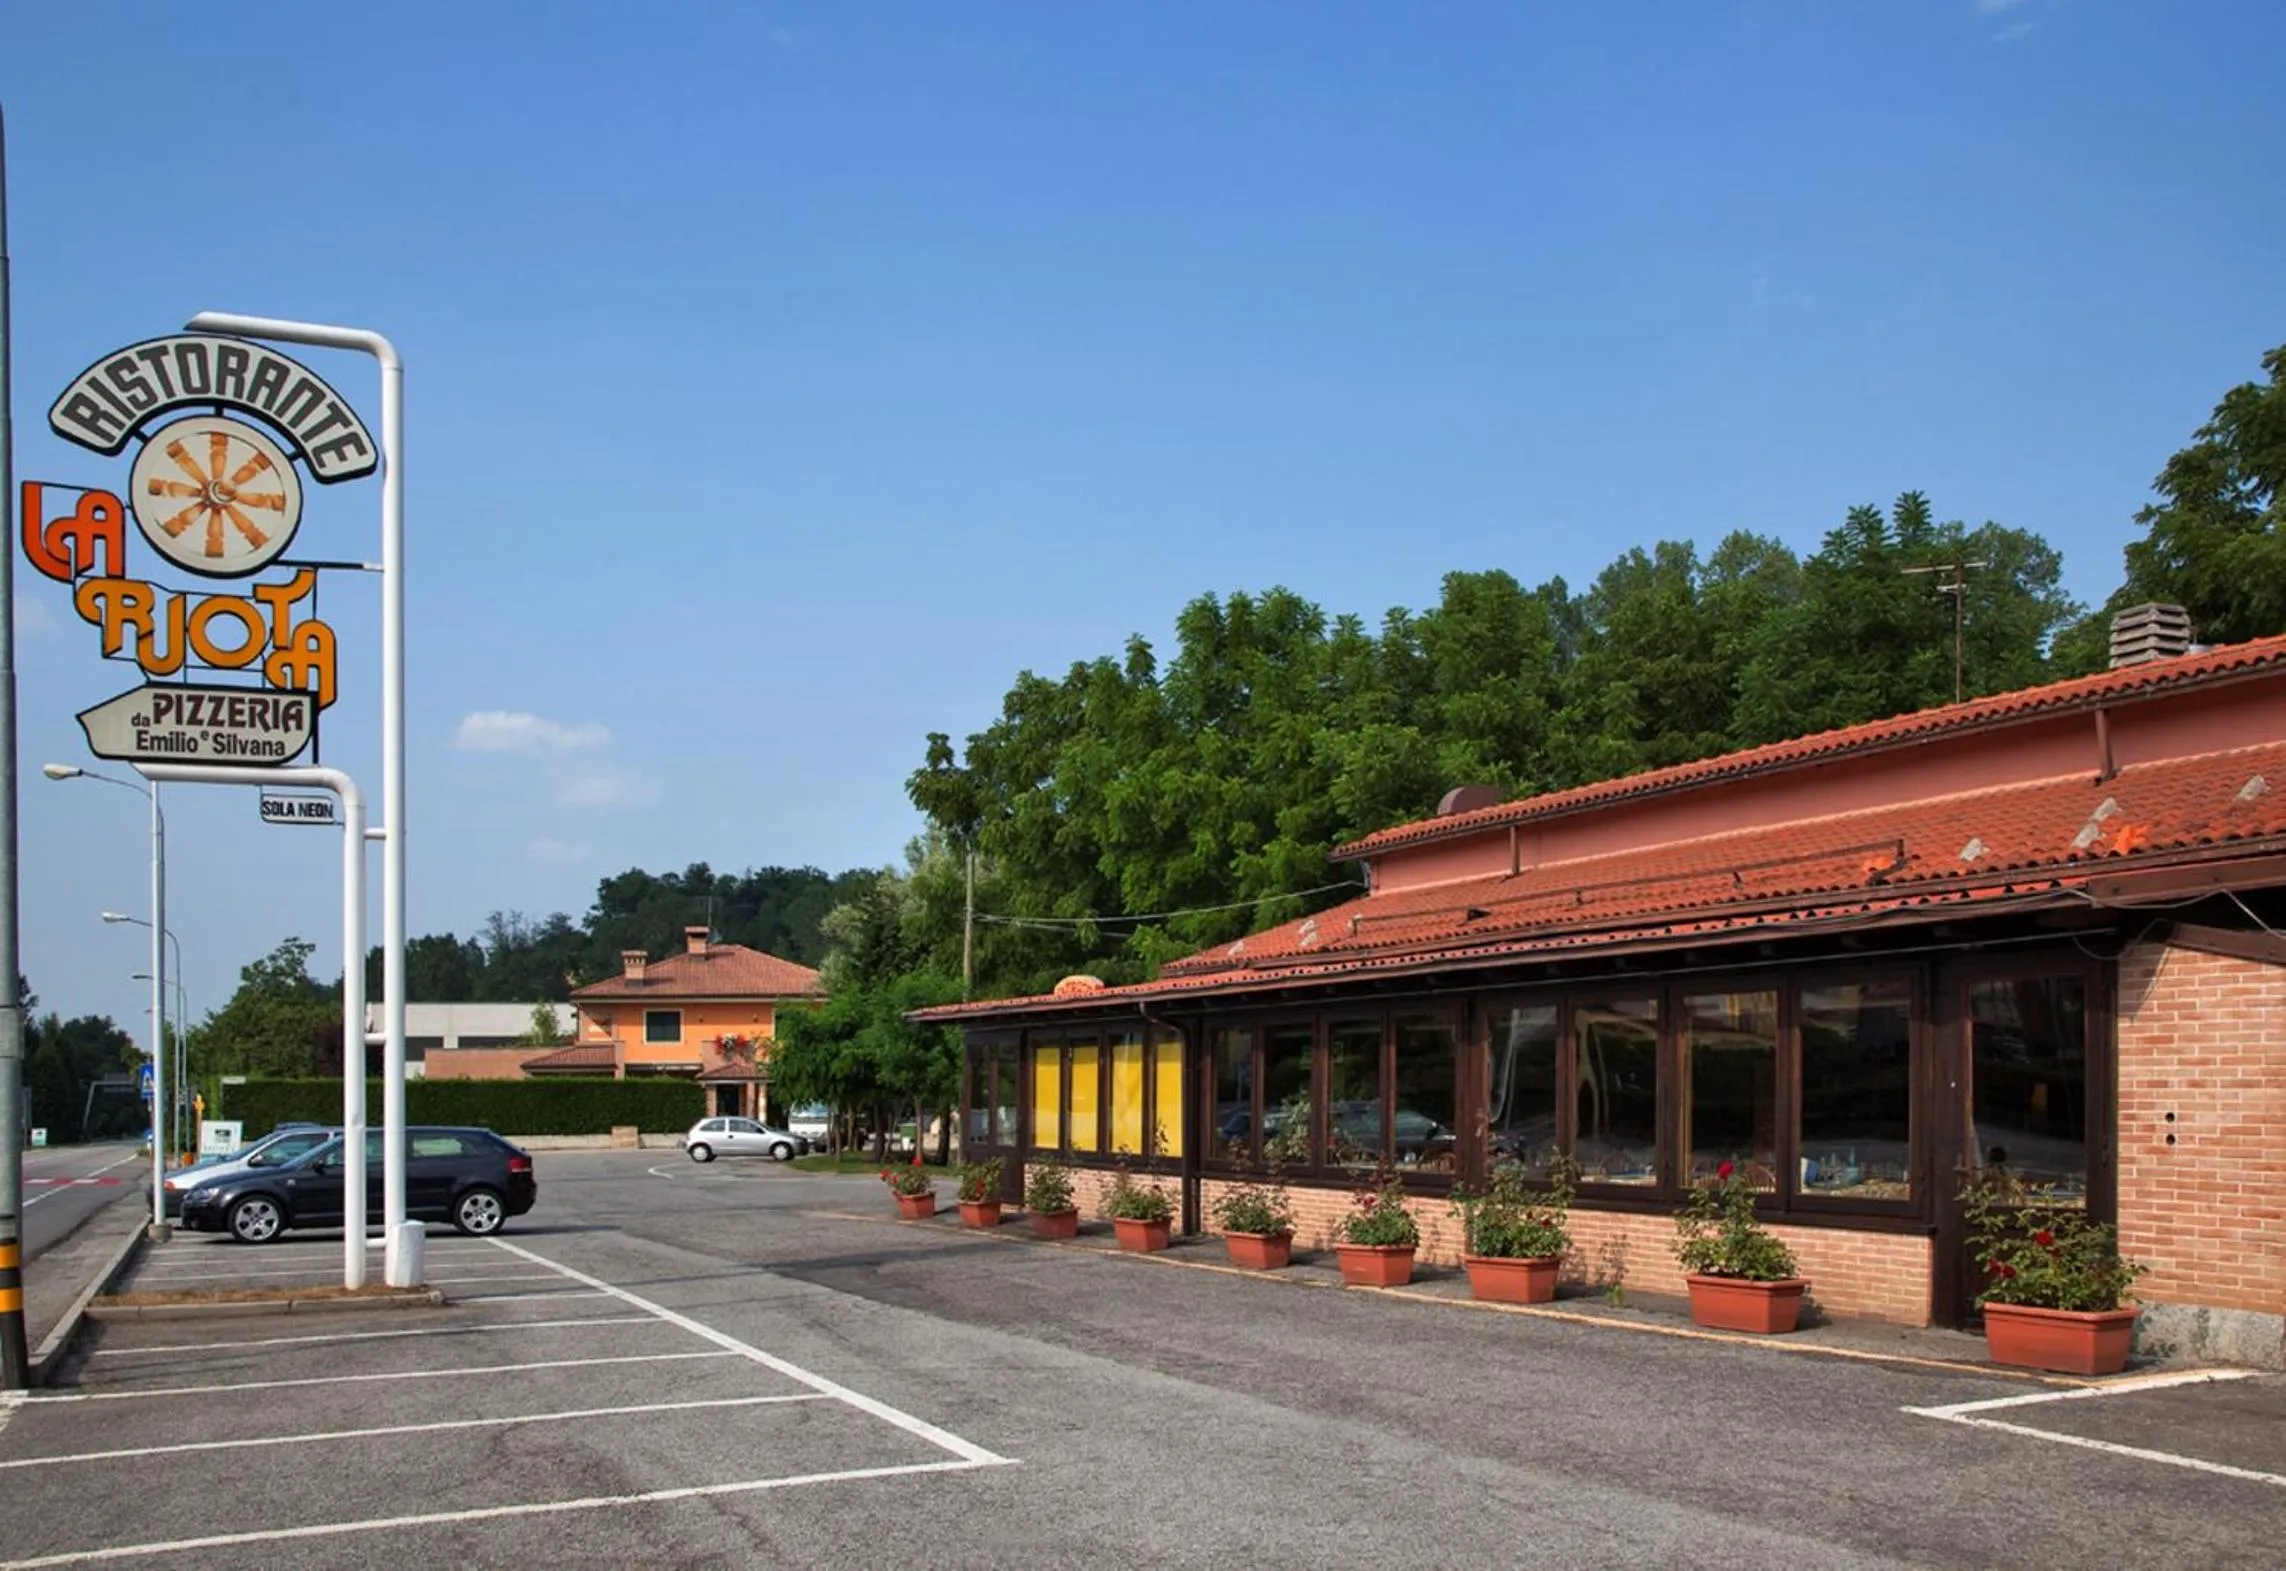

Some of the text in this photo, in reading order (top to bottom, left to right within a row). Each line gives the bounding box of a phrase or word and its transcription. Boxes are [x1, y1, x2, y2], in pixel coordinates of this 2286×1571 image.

[61, 341, 366, 471] RISTORANTE
[21, 480, 125, 584] LA
[74, 567, 336, 711] RUOTA
[131, 693, 304, 733] da PIZZERIA
[136, 730, 286, 756] Emilio e Silvana
[263, 801, 333, 818] SOLA NEON
